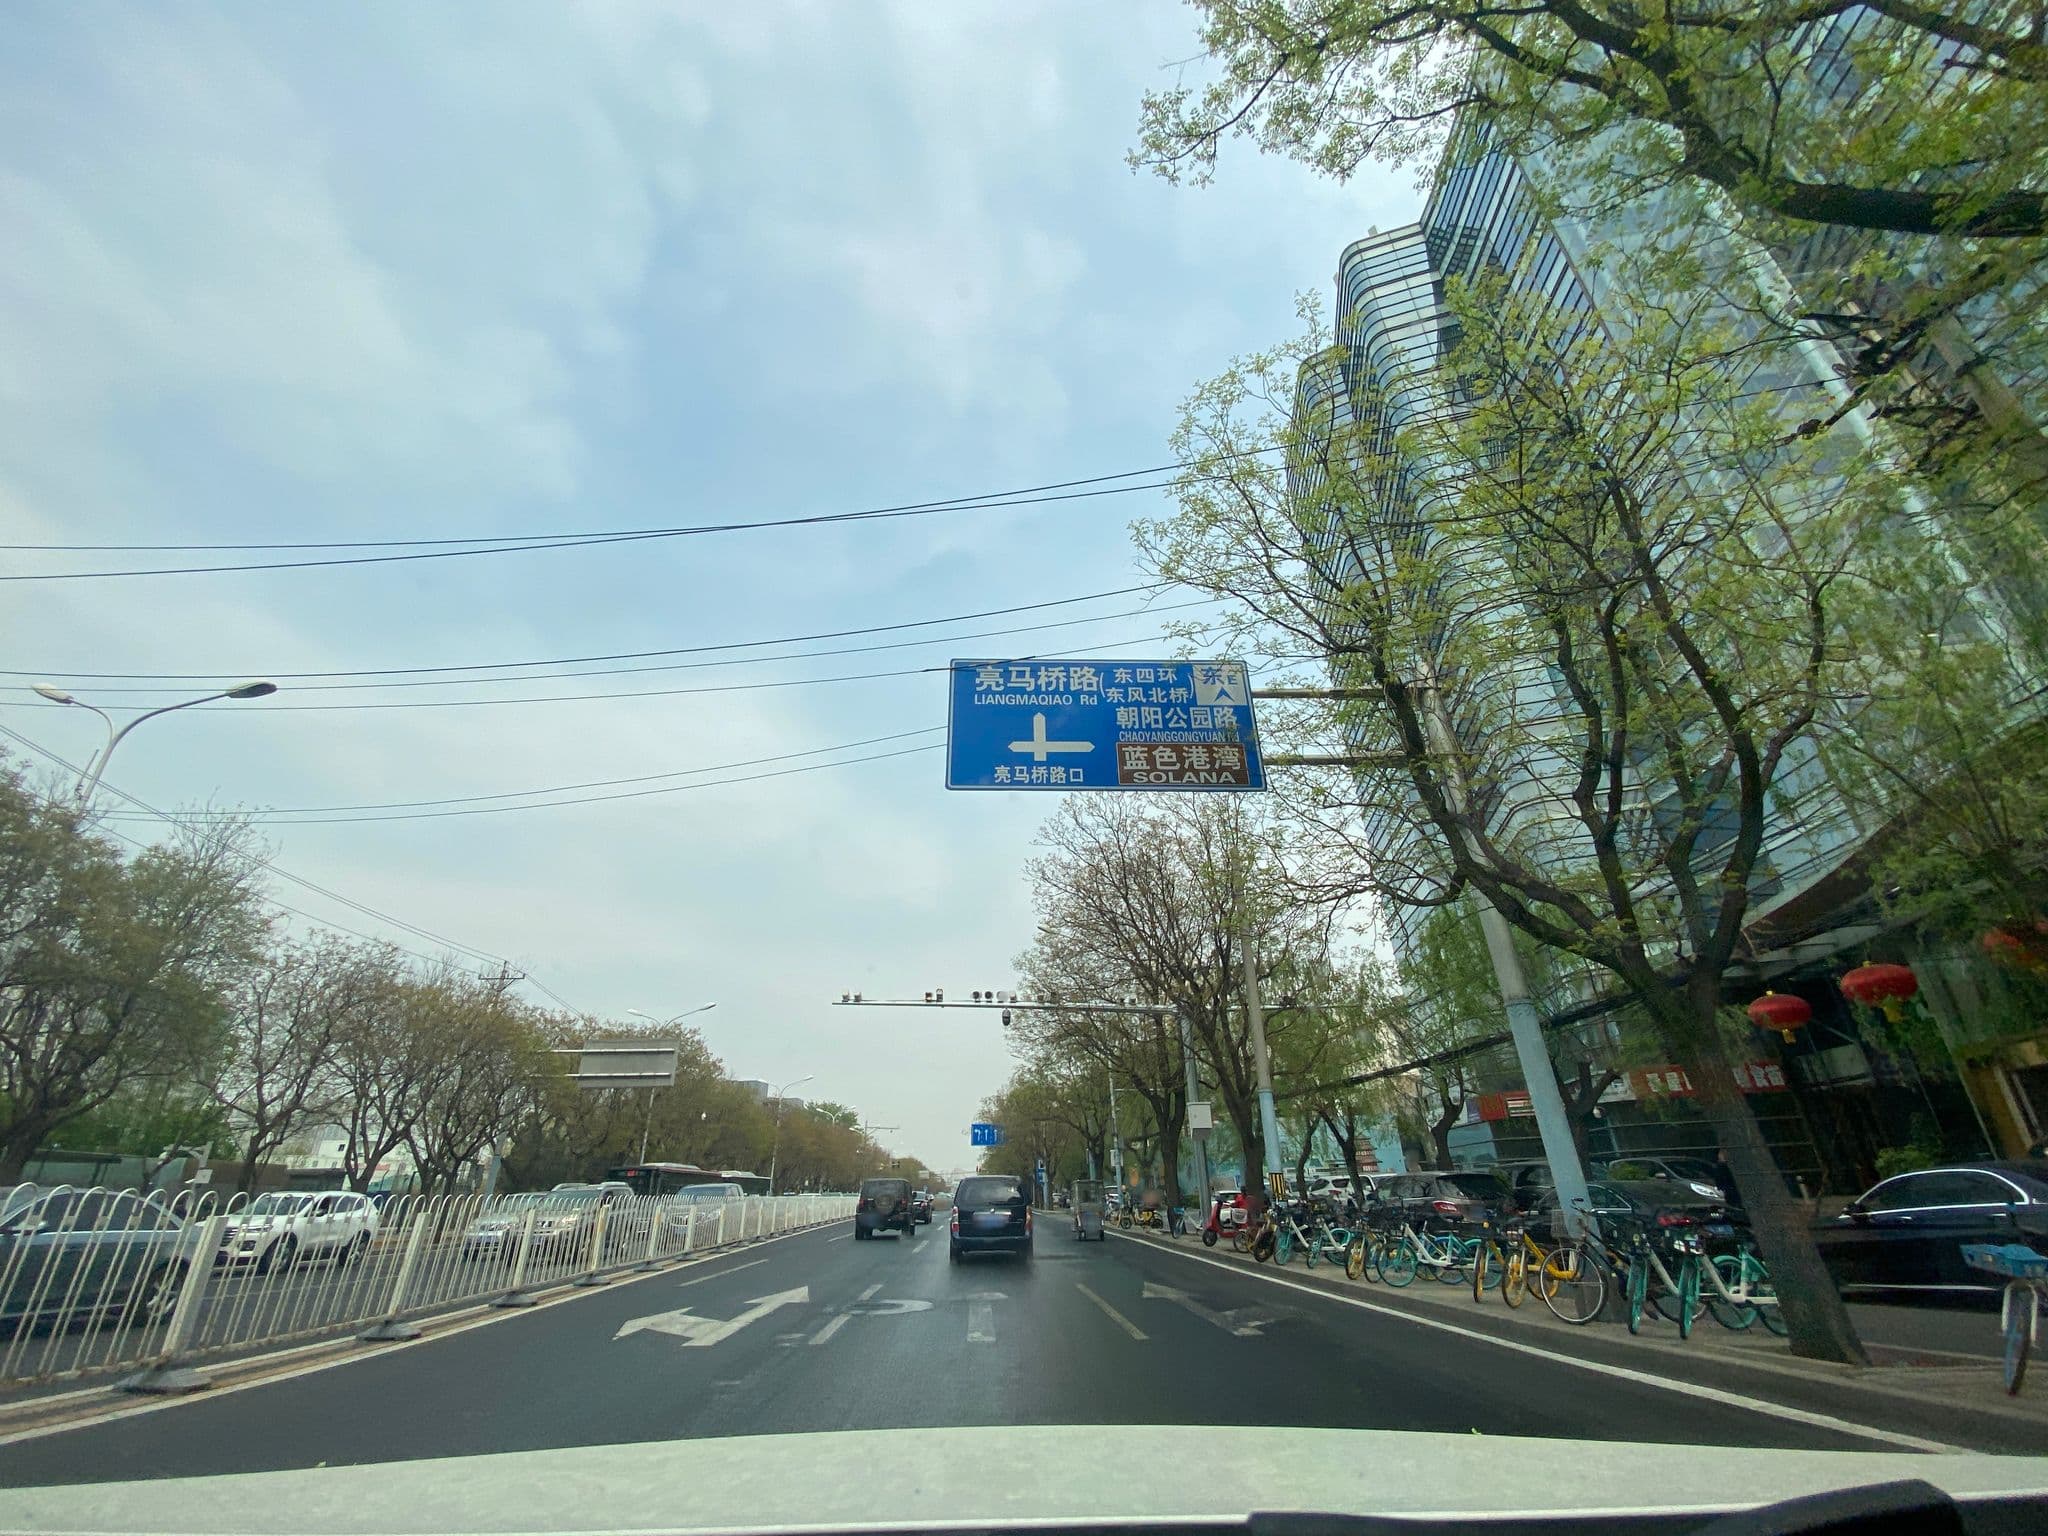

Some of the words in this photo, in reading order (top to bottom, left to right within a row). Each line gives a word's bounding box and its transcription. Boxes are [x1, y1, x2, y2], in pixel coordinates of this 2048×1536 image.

[976, 666, 1099, 692] 亮马桥路
[1113, 668, 1177, 684] 东四环
[1202, 667, 1223, 685] 东
[1228, 674, 1238, 685] E
[975, 694, 1073, 706] LIANGMAQIAO
[1080, 694, 1098, 705] Rd
[1105, 687, 1188, 704] 东风北桥
[1116, 706, 1238, 729] 朝阳公园路
[1119, 731, 1225, 742] CHAOYANGGONGYUAN
[1121, 745, 1241, 770] 蓝色港湾
[994, 765, 1084, 784] 亮马桥路口
[1133, 772, 1236, 784] SOLANA
